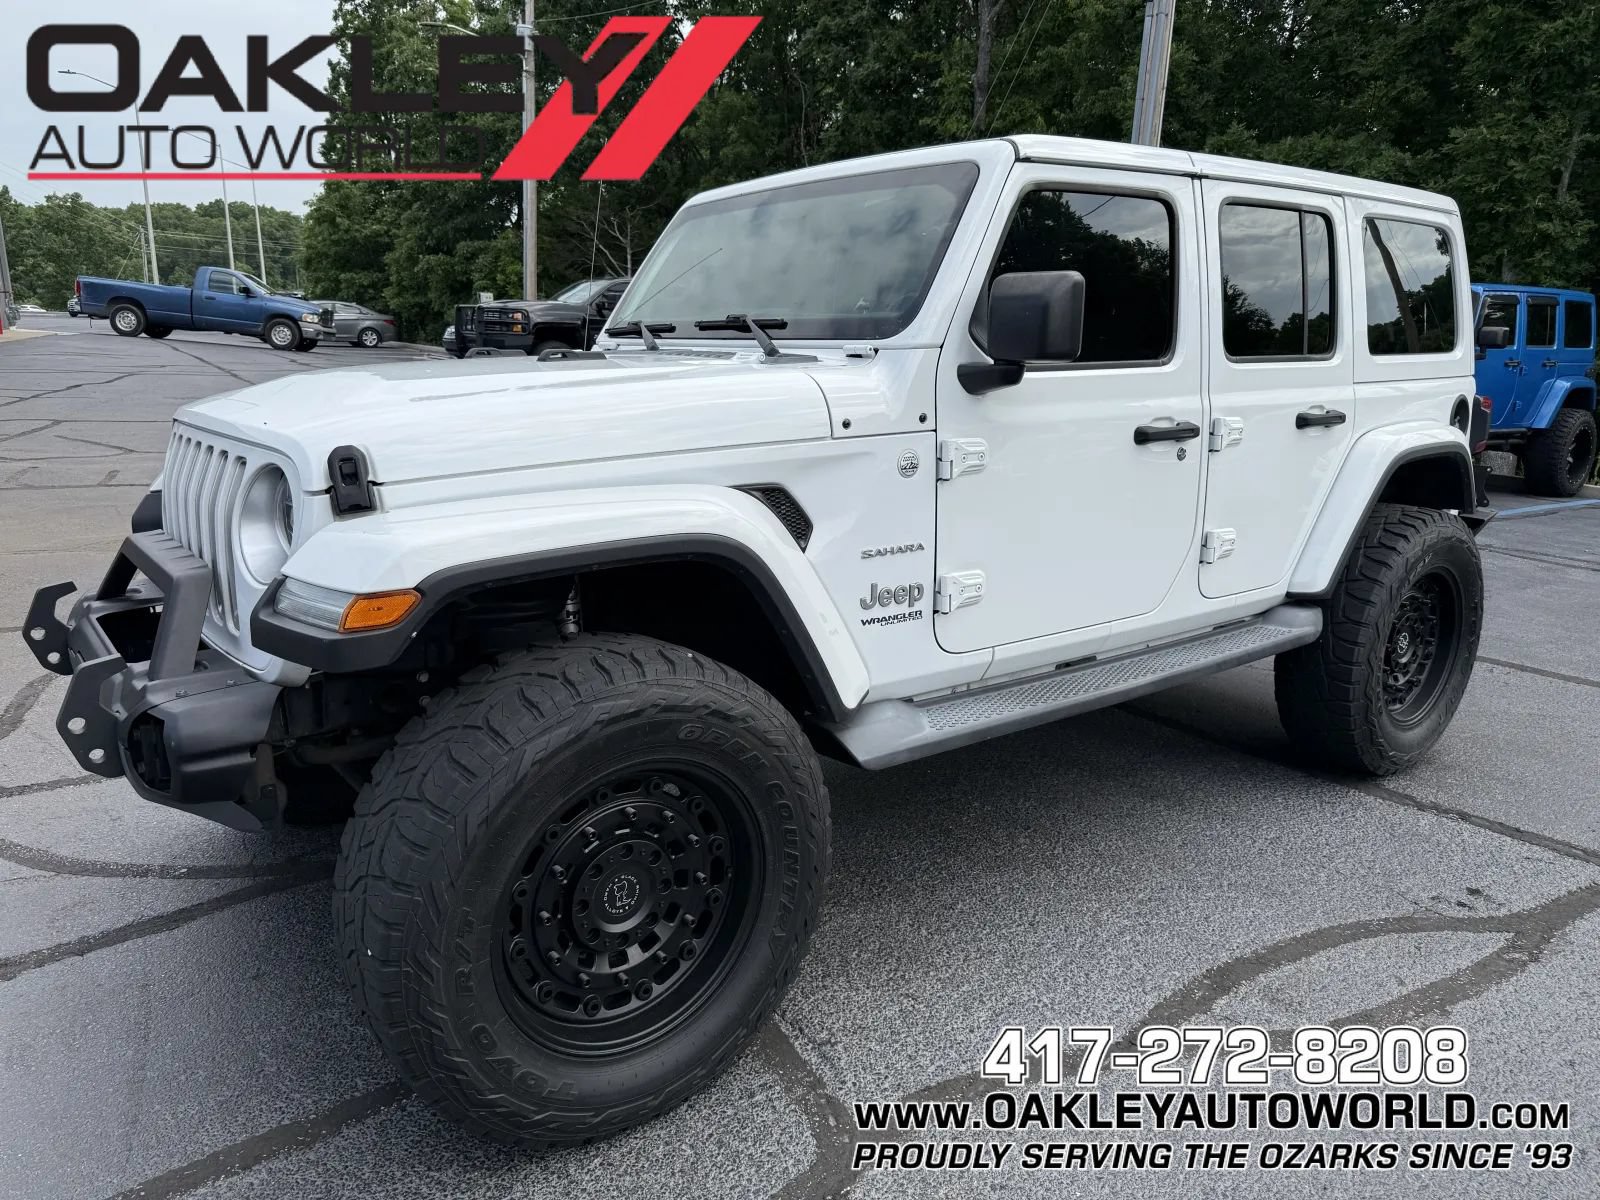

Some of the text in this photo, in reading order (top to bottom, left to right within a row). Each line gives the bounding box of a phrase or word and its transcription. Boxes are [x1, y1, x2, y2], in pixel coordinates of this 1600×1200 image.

[860, 542, 925, 560] SAHARA
[859, 582, 925, 610] Jeep
[860, 610, 923, 626] WRANGLER
[880, 615, 923, 627] UNLIMITED
[677, 723, 769, 768] OPEN
[470, 1023, 578, 1102] TOYO
